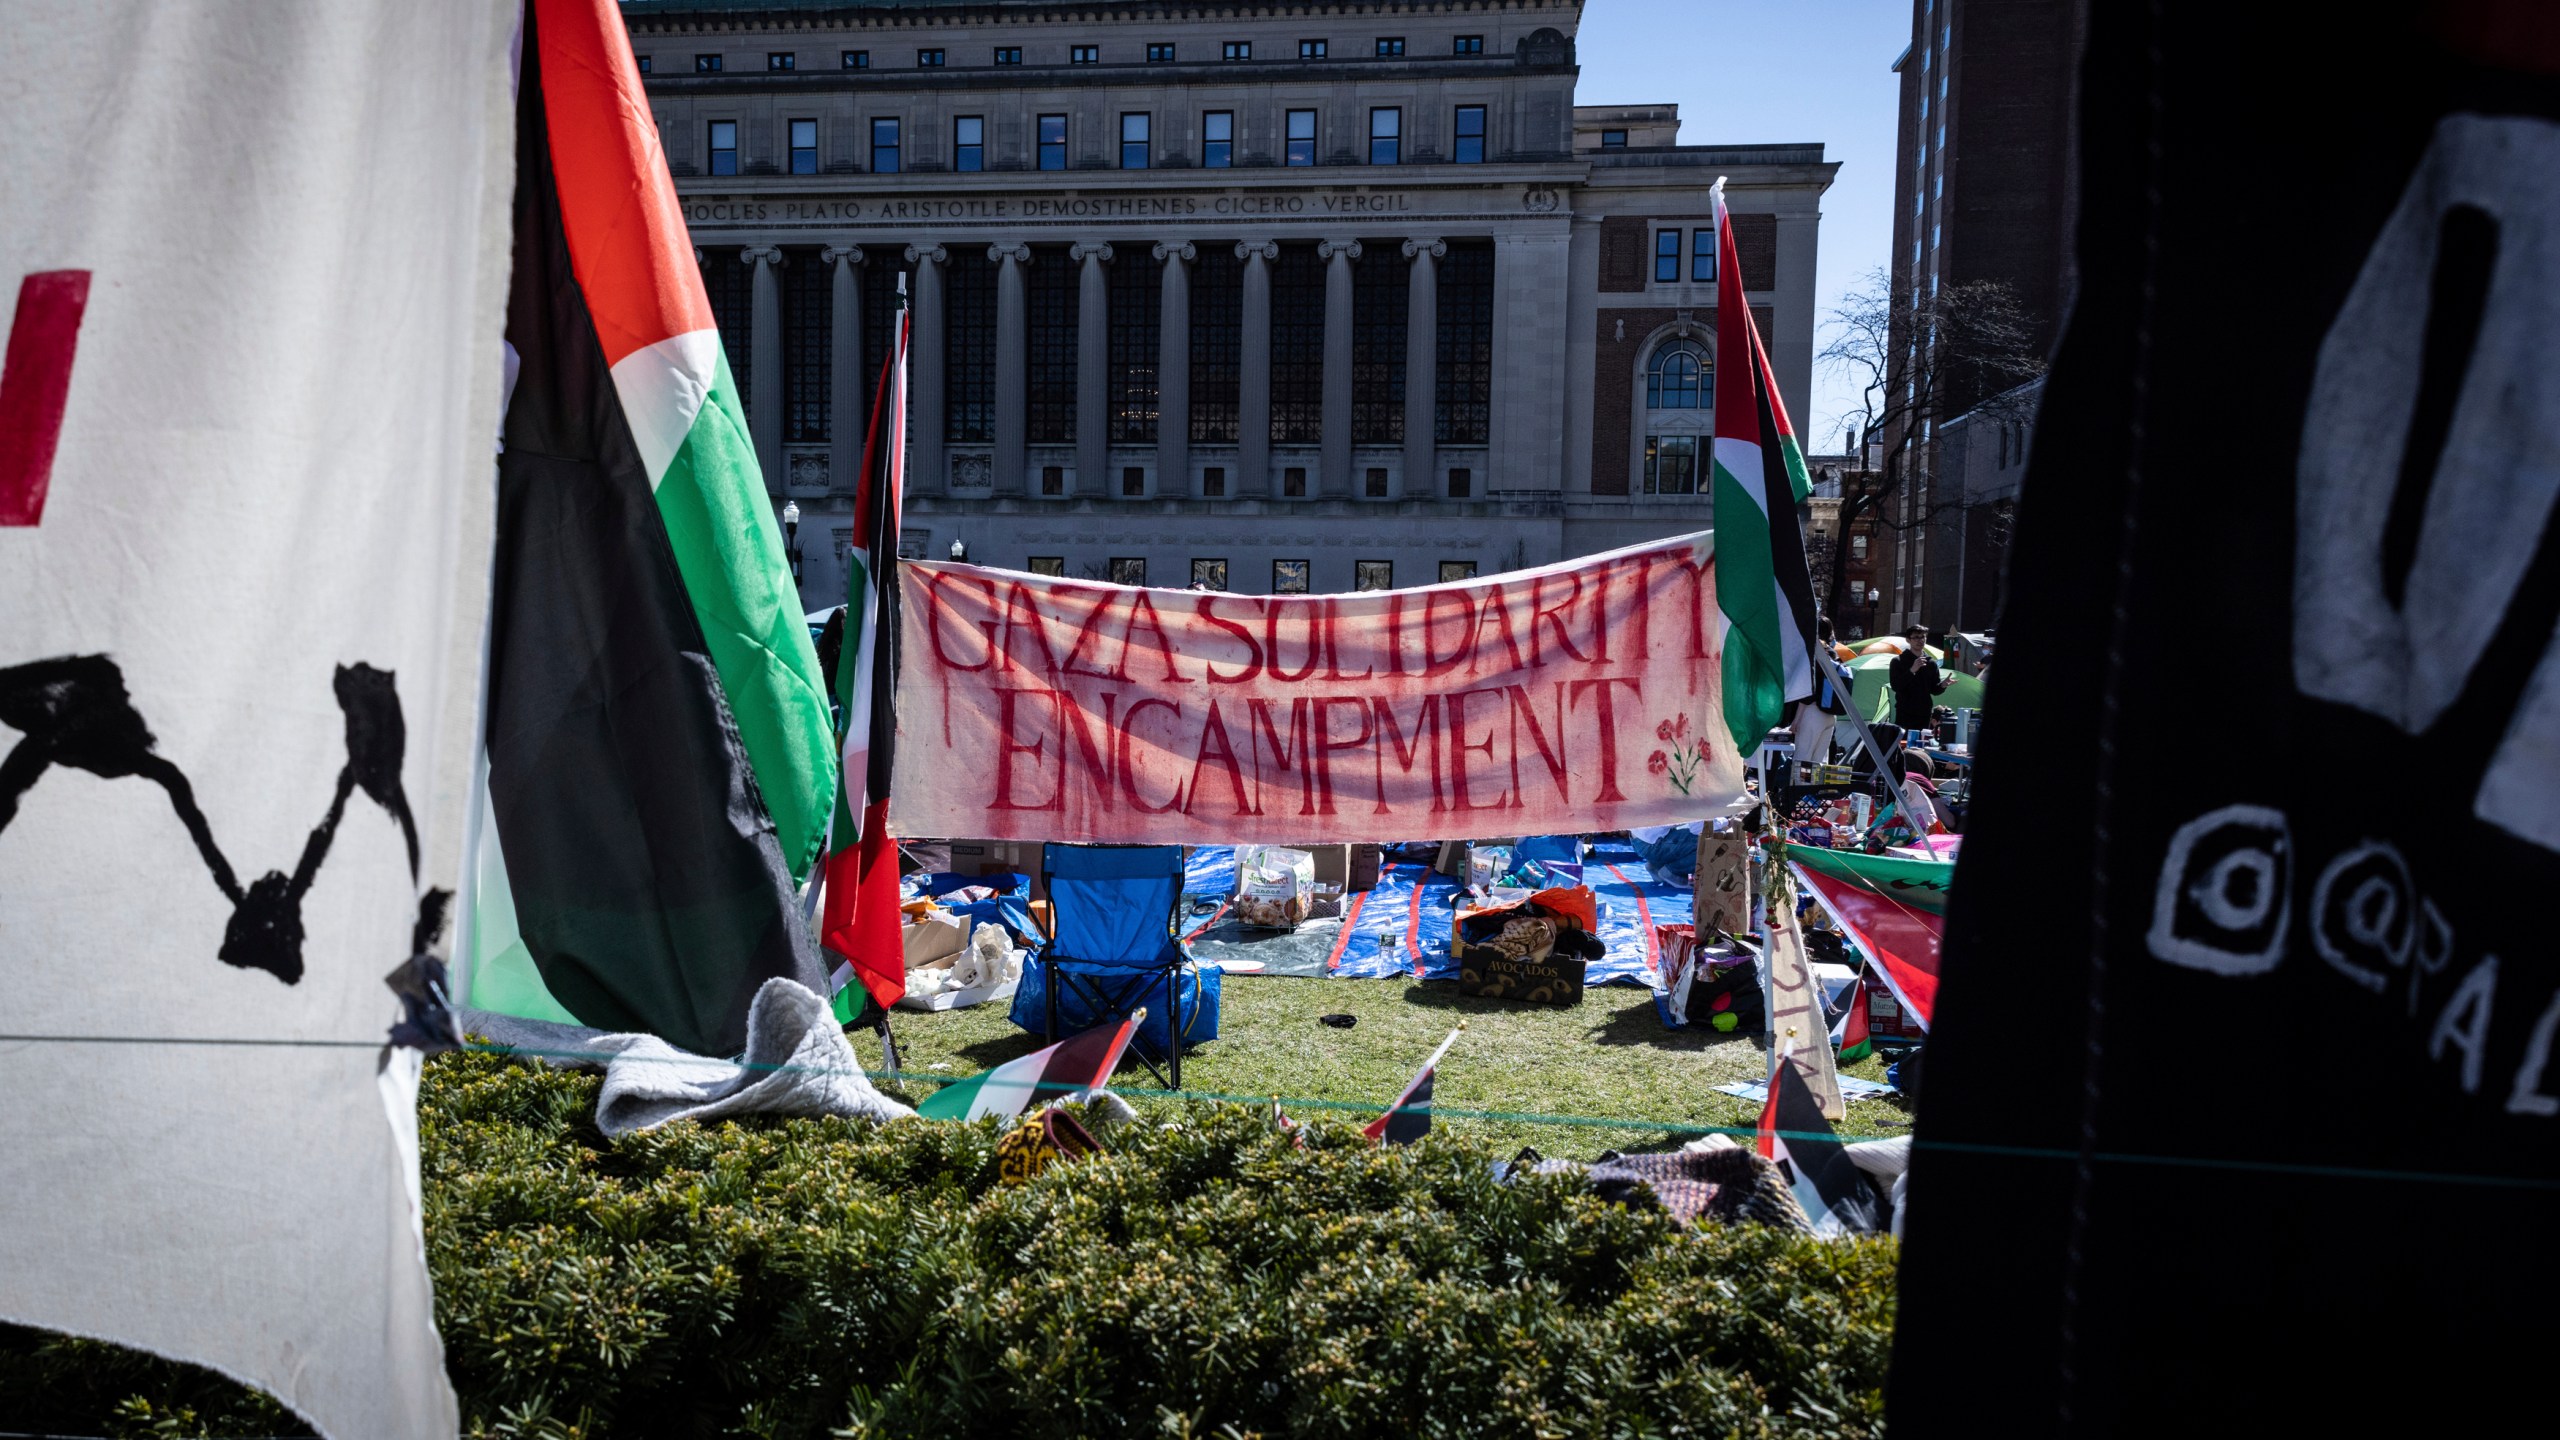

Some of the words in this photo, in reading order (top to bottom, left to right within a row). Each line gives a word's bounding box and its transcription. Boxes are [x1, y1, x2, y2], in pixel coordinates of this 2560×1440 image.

[786, 202, 860, 219] PLATO
[880, 201, 1006, 218] ARISTOTLE
[1023, 199, 1195, 216] DEMOSTHENES
[1215, 197, 1304, 214] CICERO
[1323, 195, 1410, 213] VERGIL
[928, 571, 1196, 684] GAZA
[1197, 546, 1716, 684] SOLIDARITY
[986, 677, 1643, 817] ENCAMPMENT
[953, 846, 982, 855] MEDIUM
[1488, 961, 1559, 978] AVOCADOS
